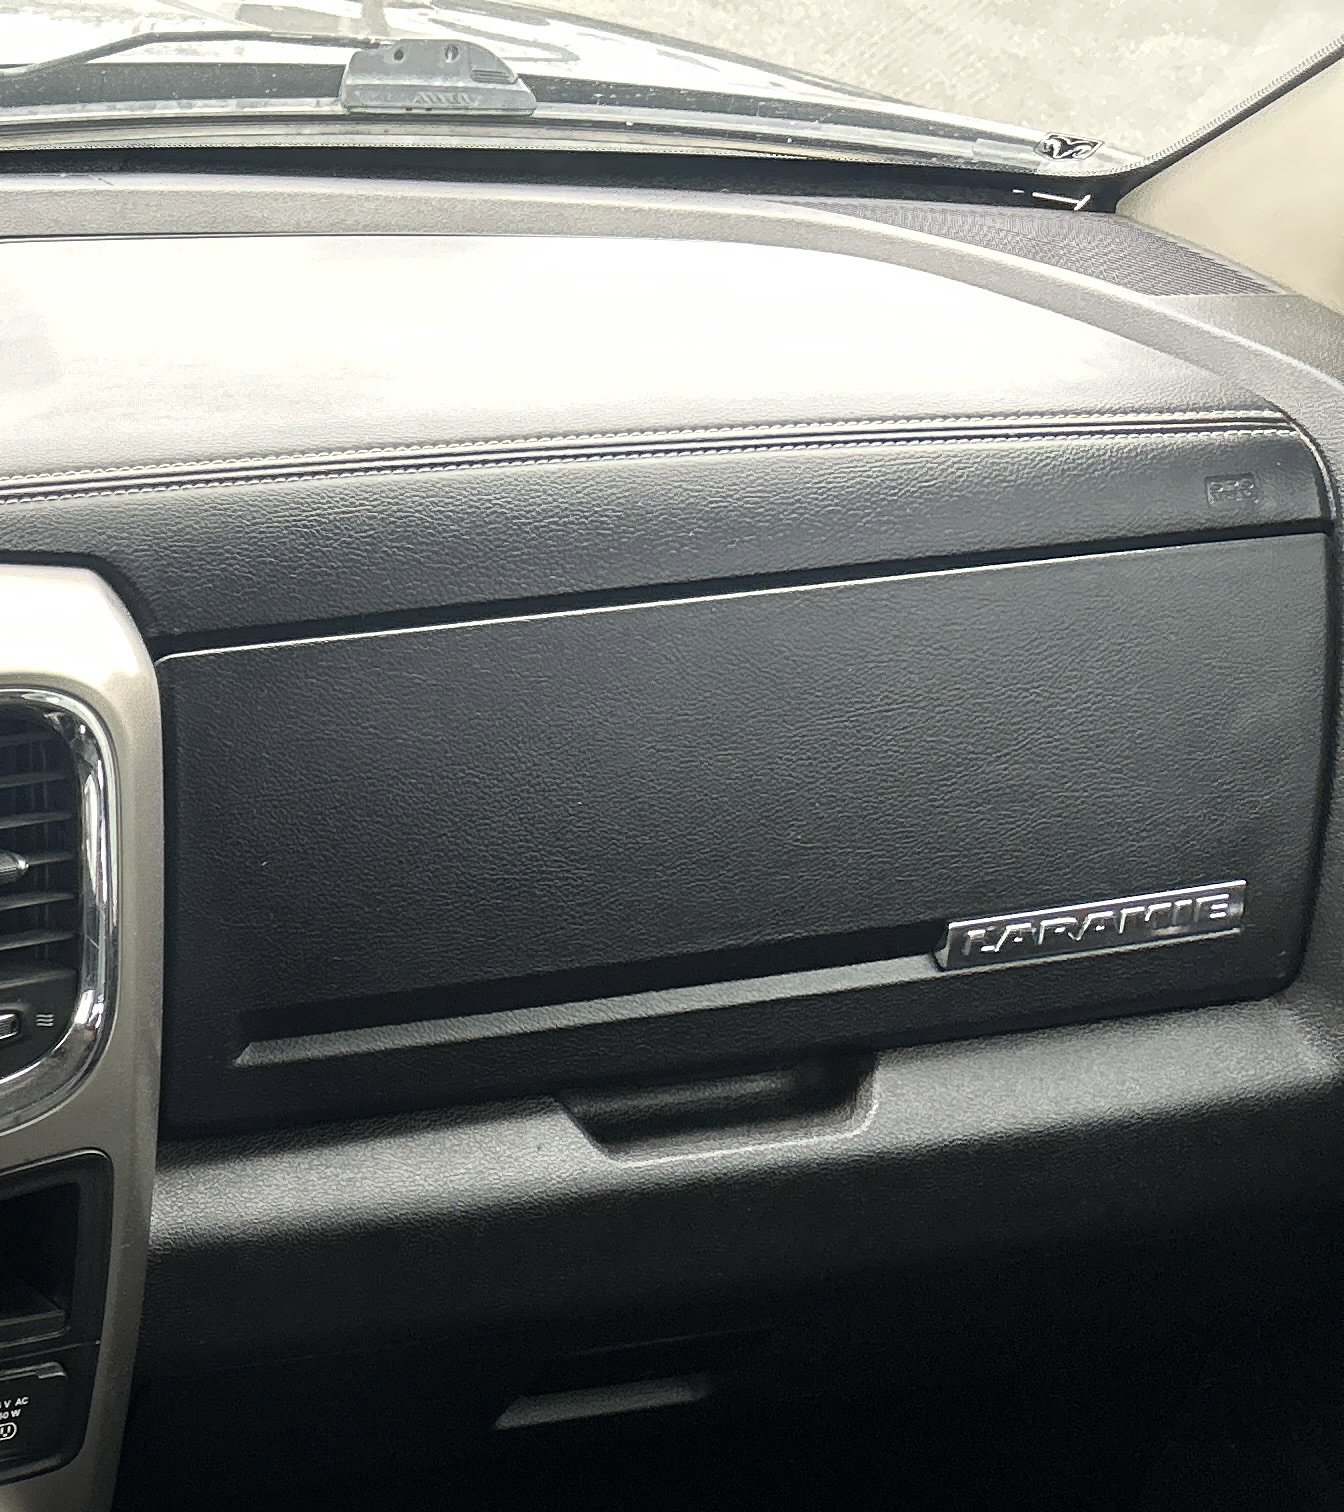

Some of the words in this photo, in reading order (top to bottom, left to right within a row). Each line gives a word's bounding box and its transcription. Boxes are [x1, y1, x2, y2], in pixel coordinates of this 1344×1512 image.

[3, 1399, 12, 1408] V
[15, 1396, 29, 1406] AC
[10, 1408, 21, 1418] W
